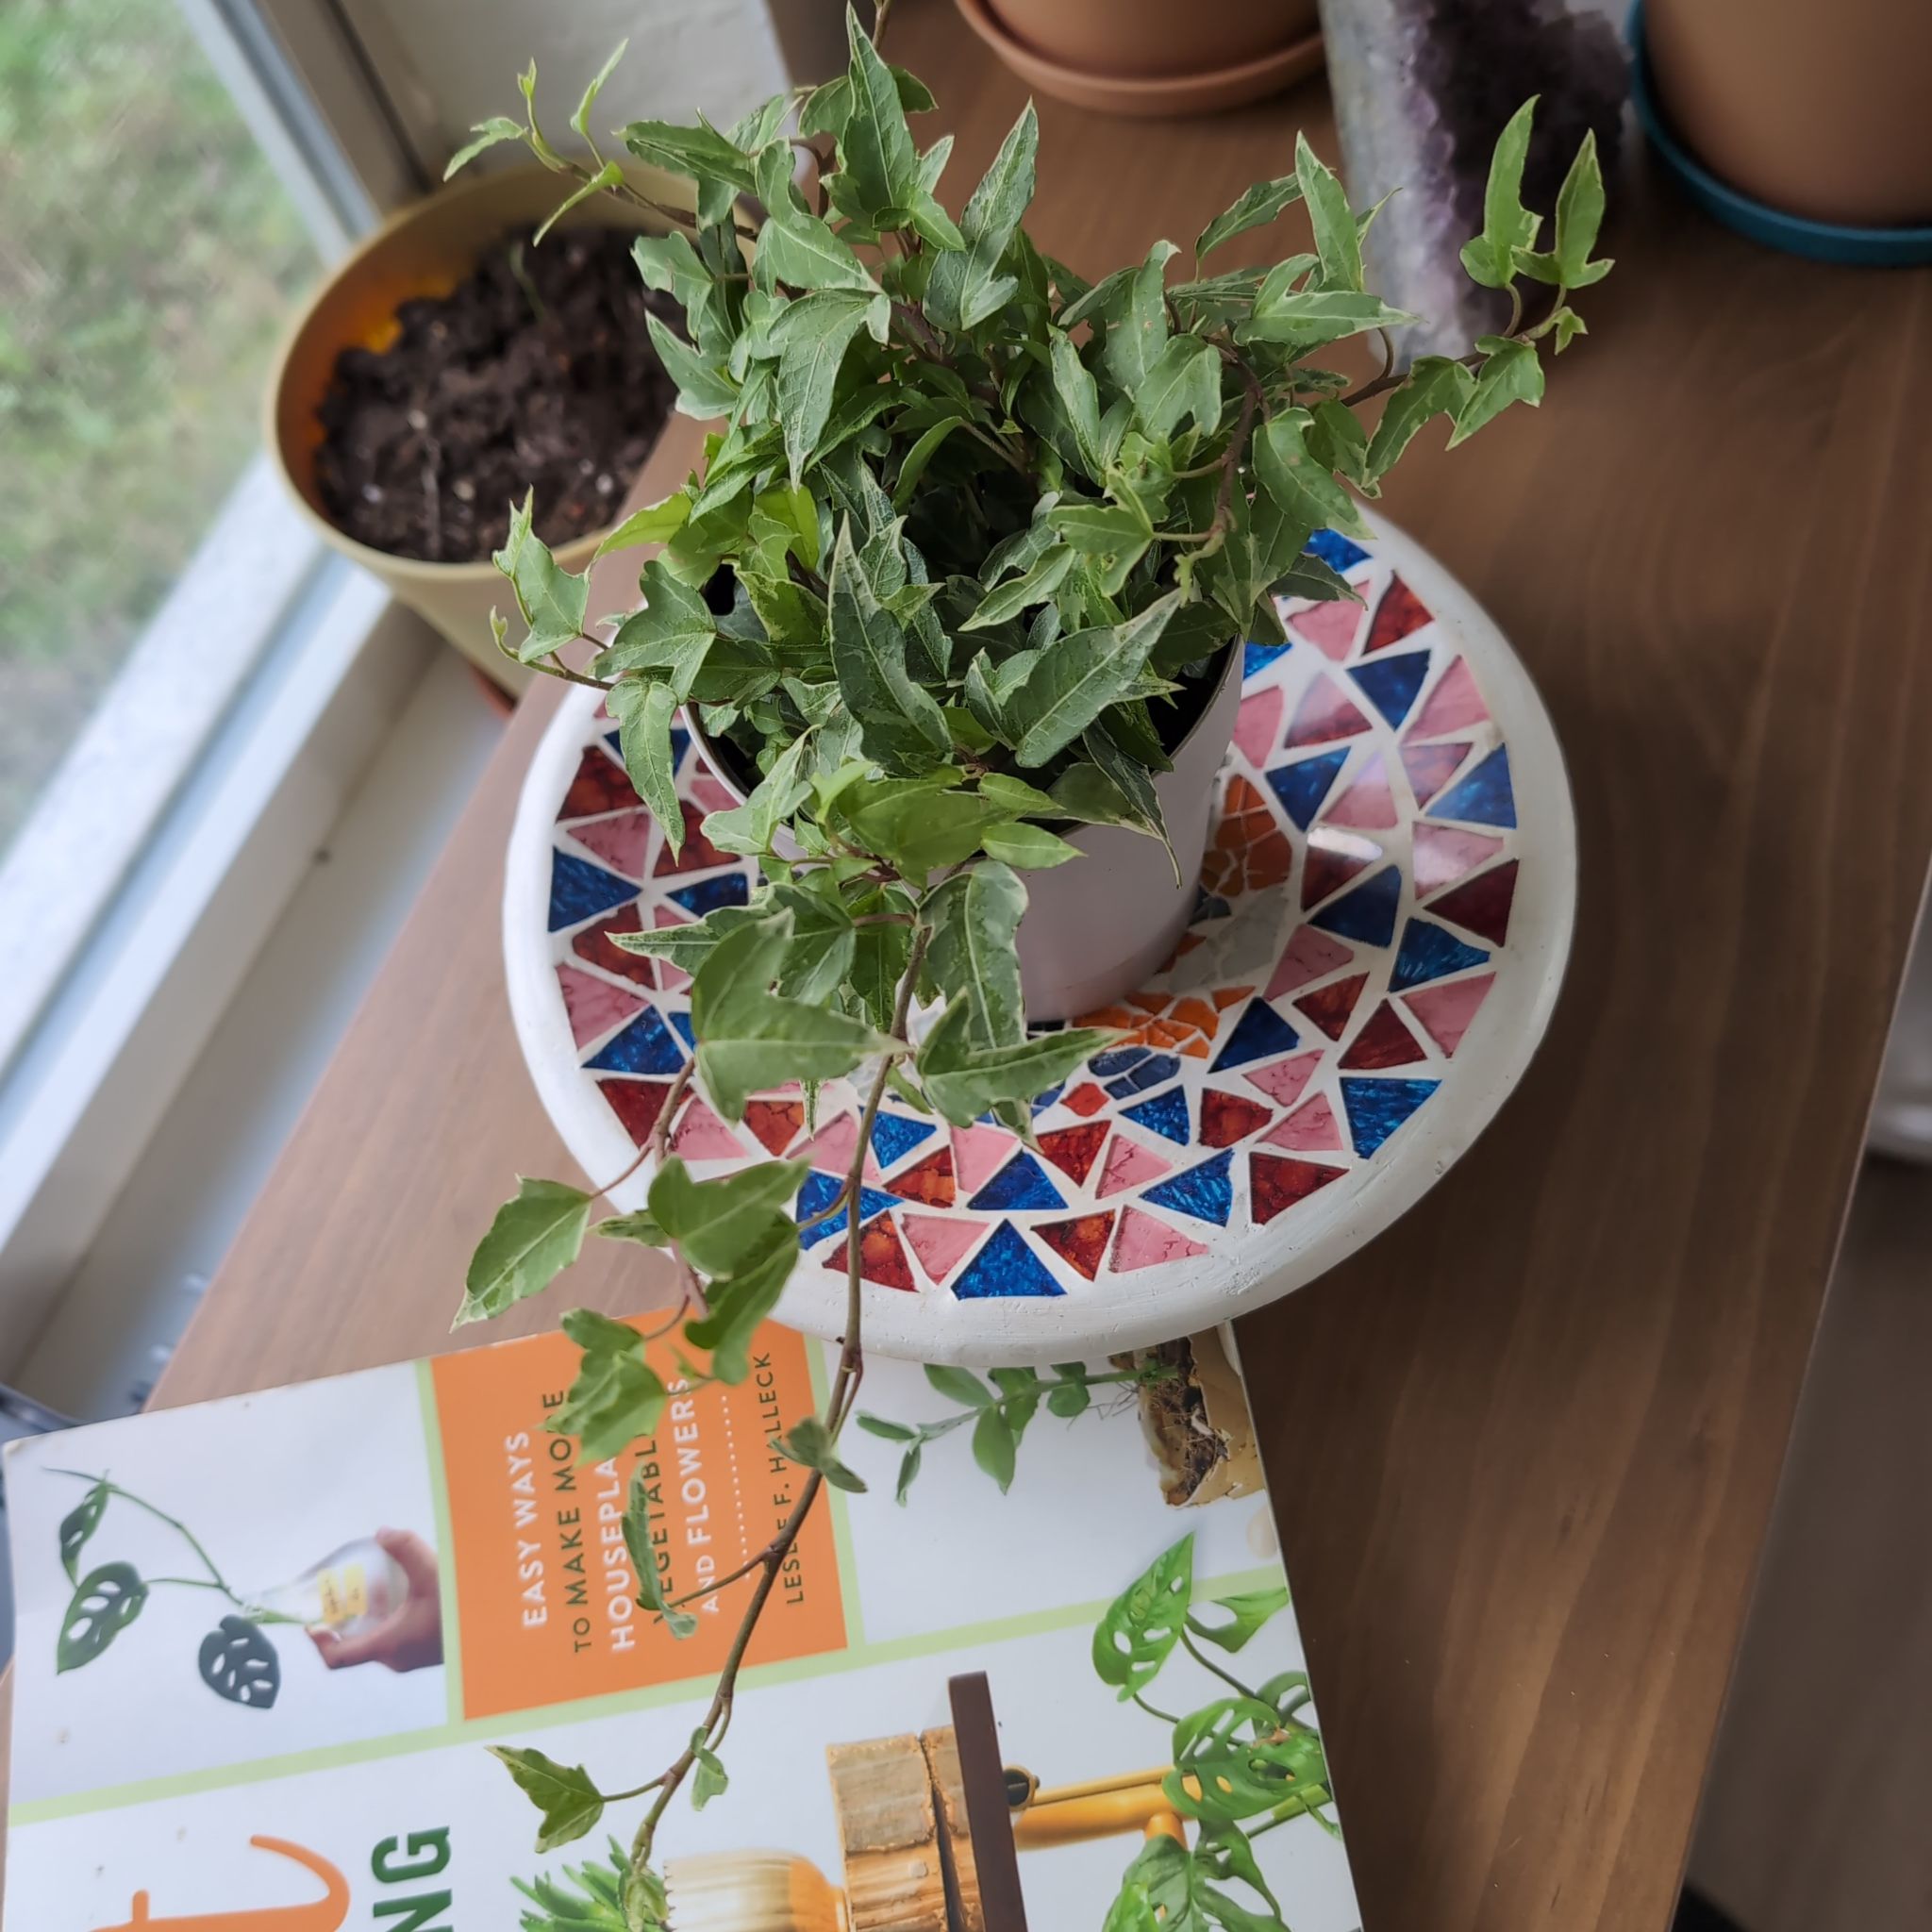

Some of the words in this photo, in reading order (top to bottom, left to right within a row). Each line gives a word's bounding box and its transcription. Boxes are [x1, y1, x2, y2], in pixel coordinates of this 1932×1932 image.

[505, 1431, 538, 1529] WAYS
[541, 1390, 577, 1492] MOE
[668, 1377, 711, 1547] FLOWERS
[773, 1483, 792, 1506] F.
[517, 1539, 548, 1628] EASY
[558, 1507, 590, 1607] MAKE
[695, 1555, 720, 1614] AND
[776, 1518, 805, 1607] LESLE
[573, 1617, 592, 1654] TO
